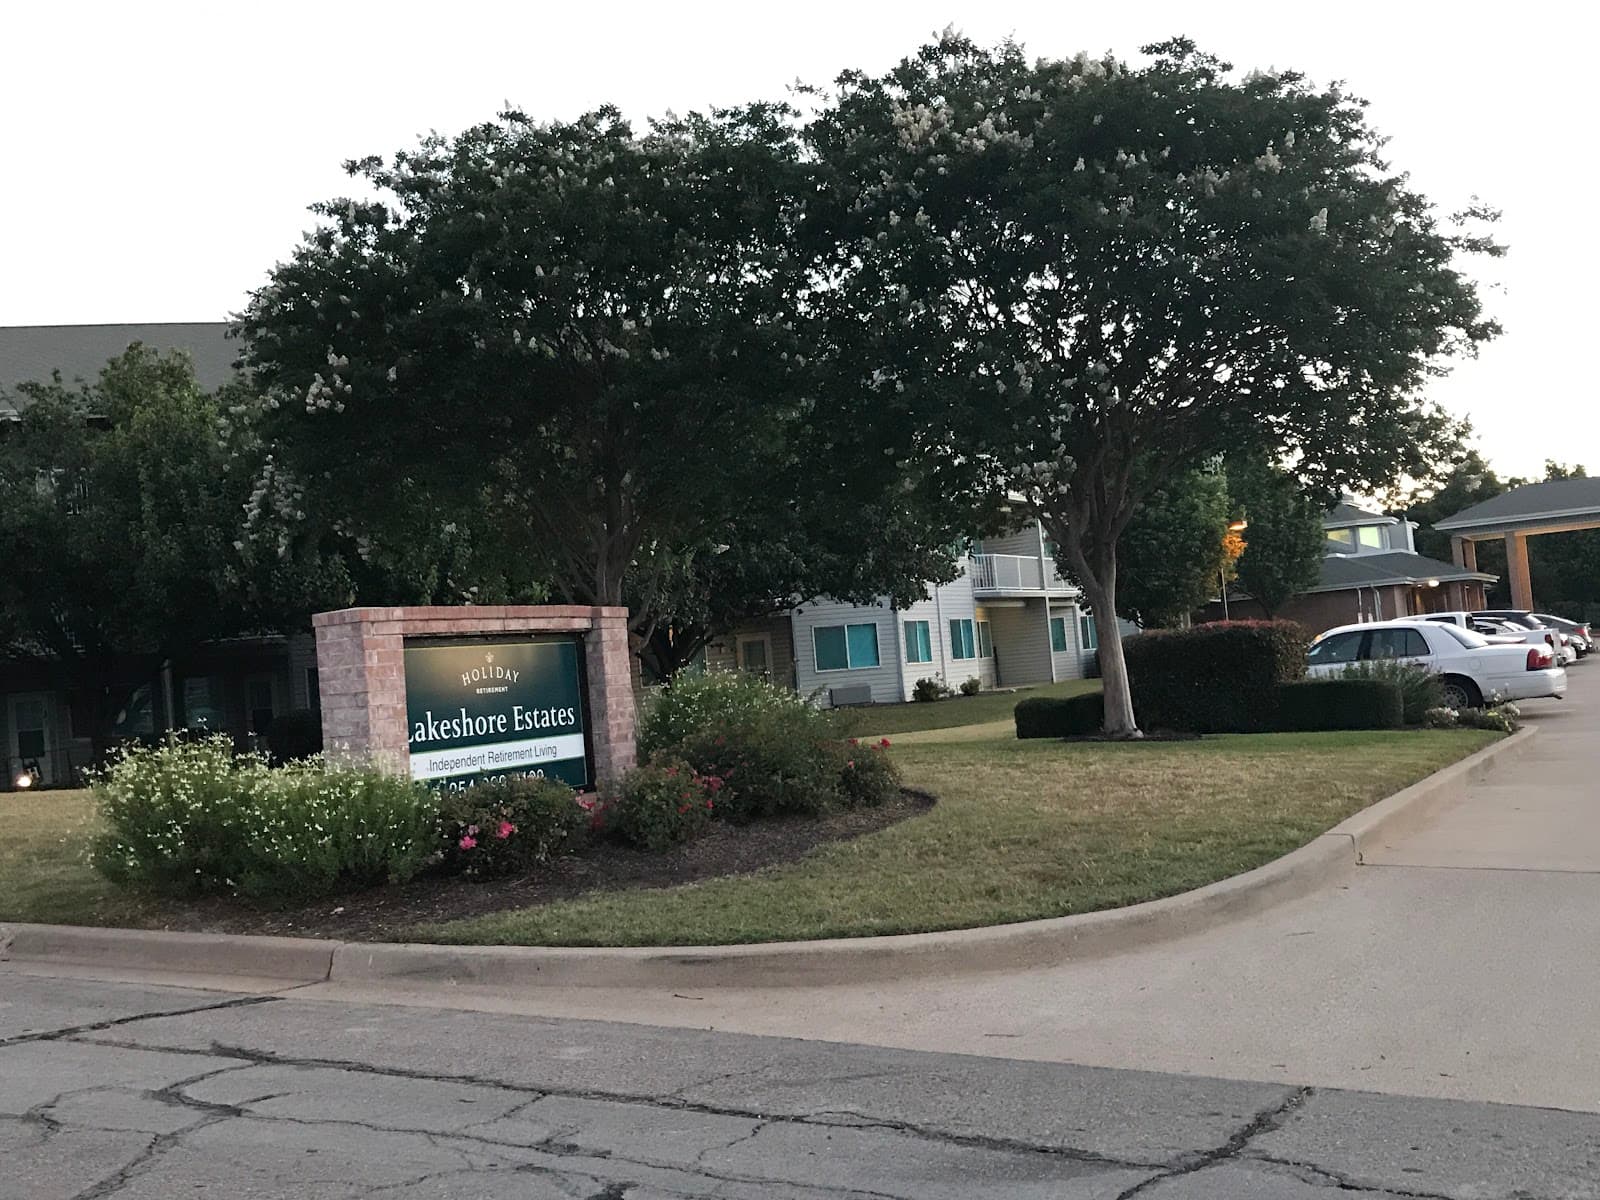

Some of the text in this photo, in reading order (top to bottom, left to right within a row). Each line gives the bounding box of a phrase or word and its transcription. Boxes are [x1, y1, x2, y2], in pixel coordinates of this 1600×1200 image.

[461, 665, 520, 687] HOLIDAY
[475, 686, 509, 695] RETIREMENT
[408, 705, 575, 743] akeshore Estates
[429, 744, 557, 772] Independent Retirement Living
